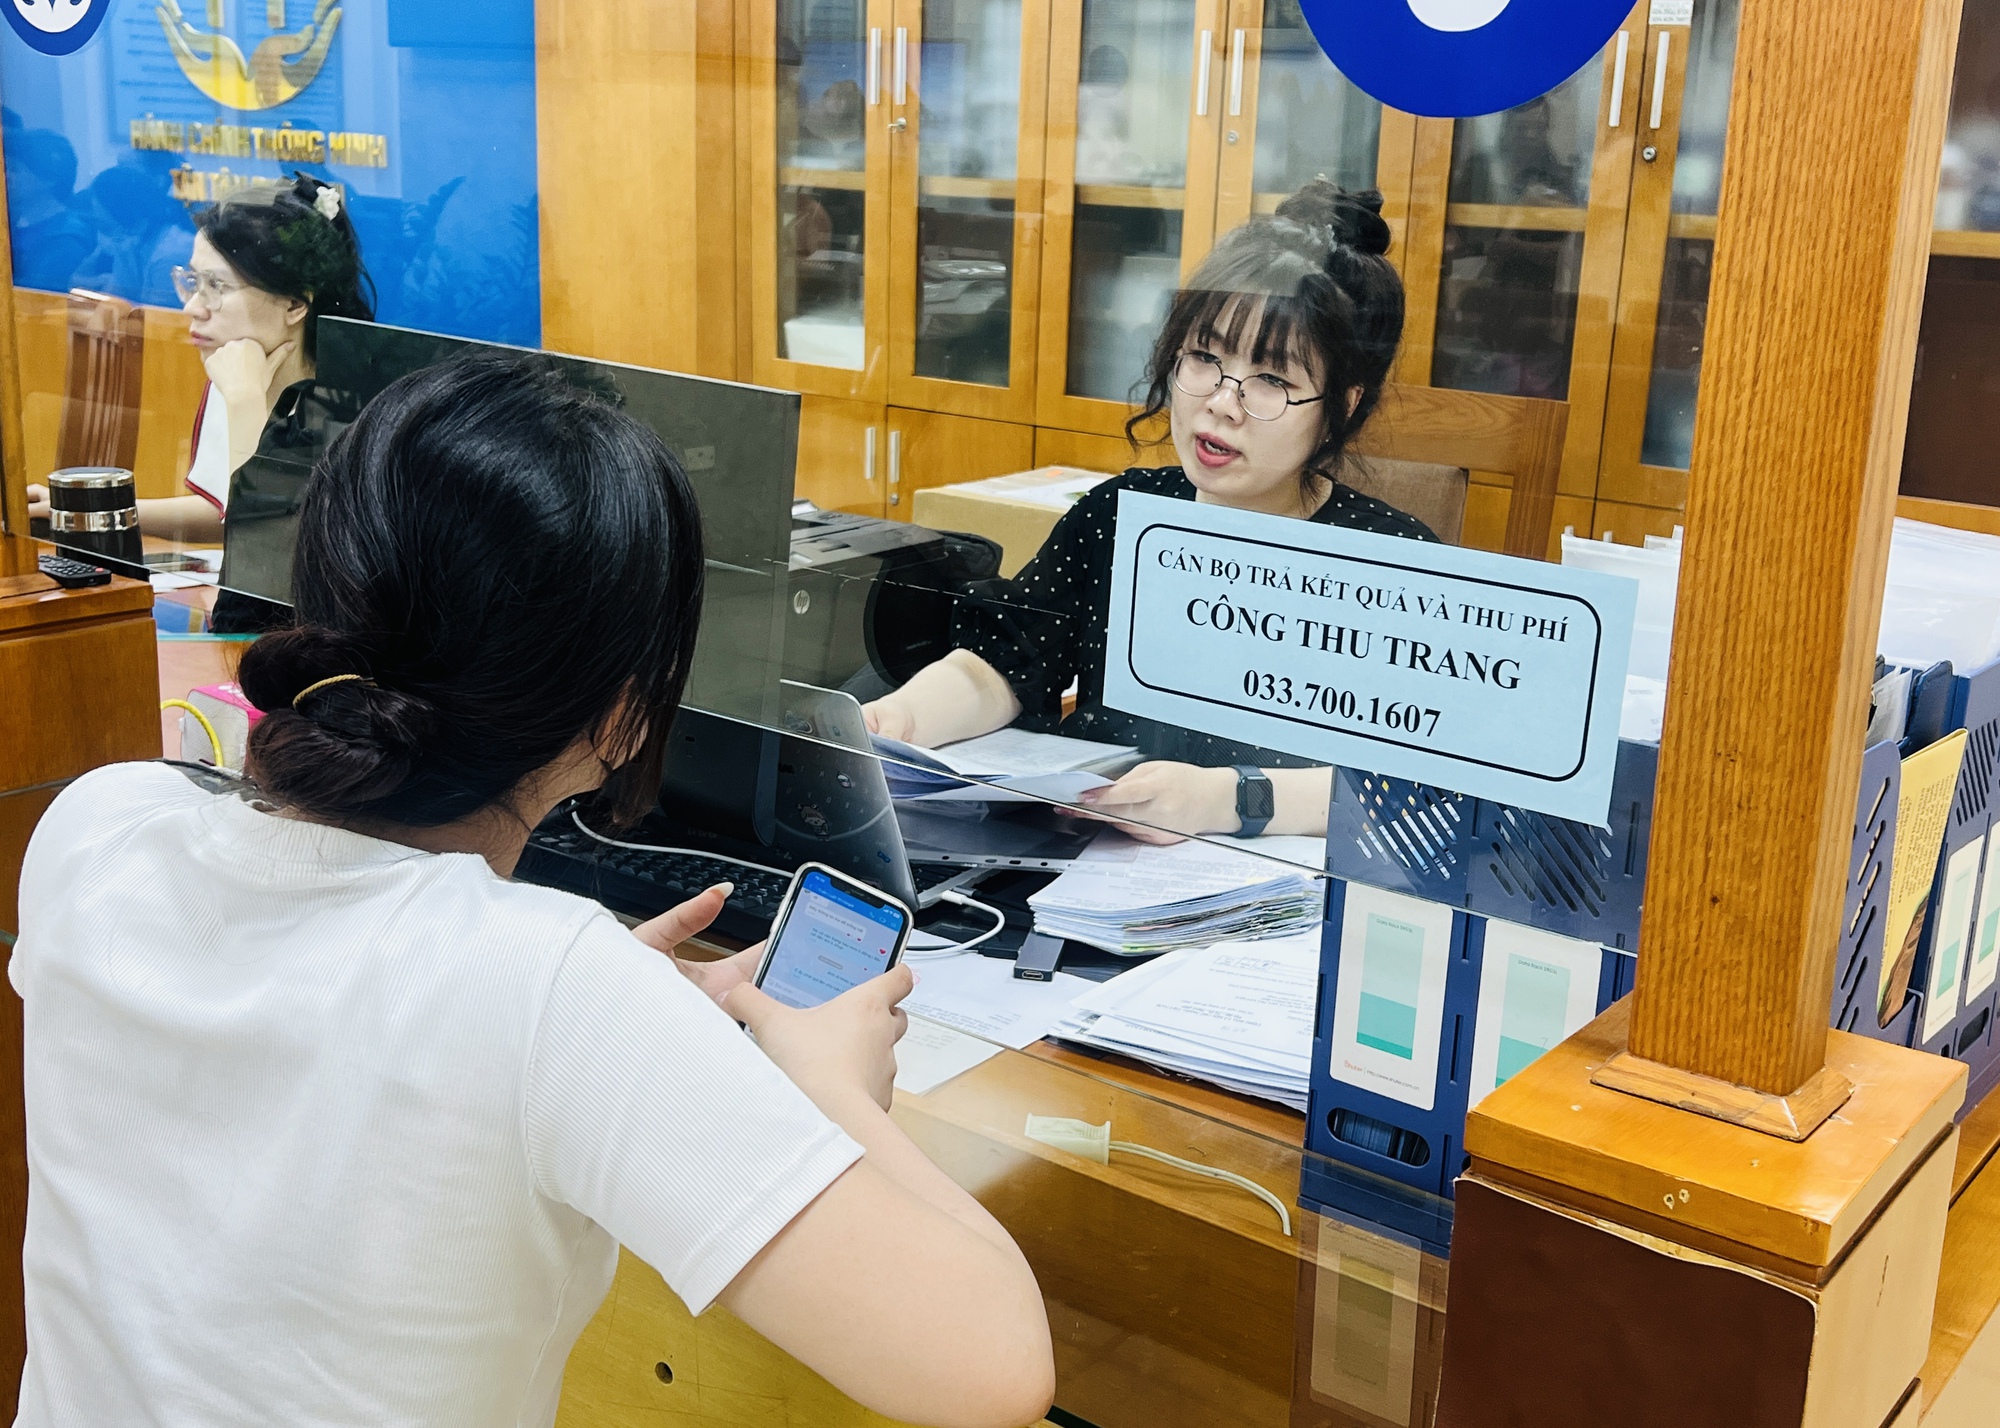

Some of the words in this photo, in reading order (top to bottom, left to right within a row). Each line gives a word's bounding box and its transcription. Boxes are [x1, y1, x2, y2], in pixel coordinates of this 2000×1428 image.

[1158, 547, 1202, 577] CÁN
[1210, 556, 1241, 585] BỘ
[1247, 564, 1293, 592] TRẢ
[1300, 571, 1350, 601] KẾT
[1355, 583, 1408, 613] QUẢ
[1417, 592, 1451, 621] VÀ
[1458, 603, 1513, 632] THU
[1522, 615, 1569, 643] PHÍ
[1186, 594, 1285, 642] CÔNG
[1296, 618, 1373, 659] THU
[1383, 635, 1520, 690] TRANG
[1243, 669, 1442, 737] 033.700.1607
